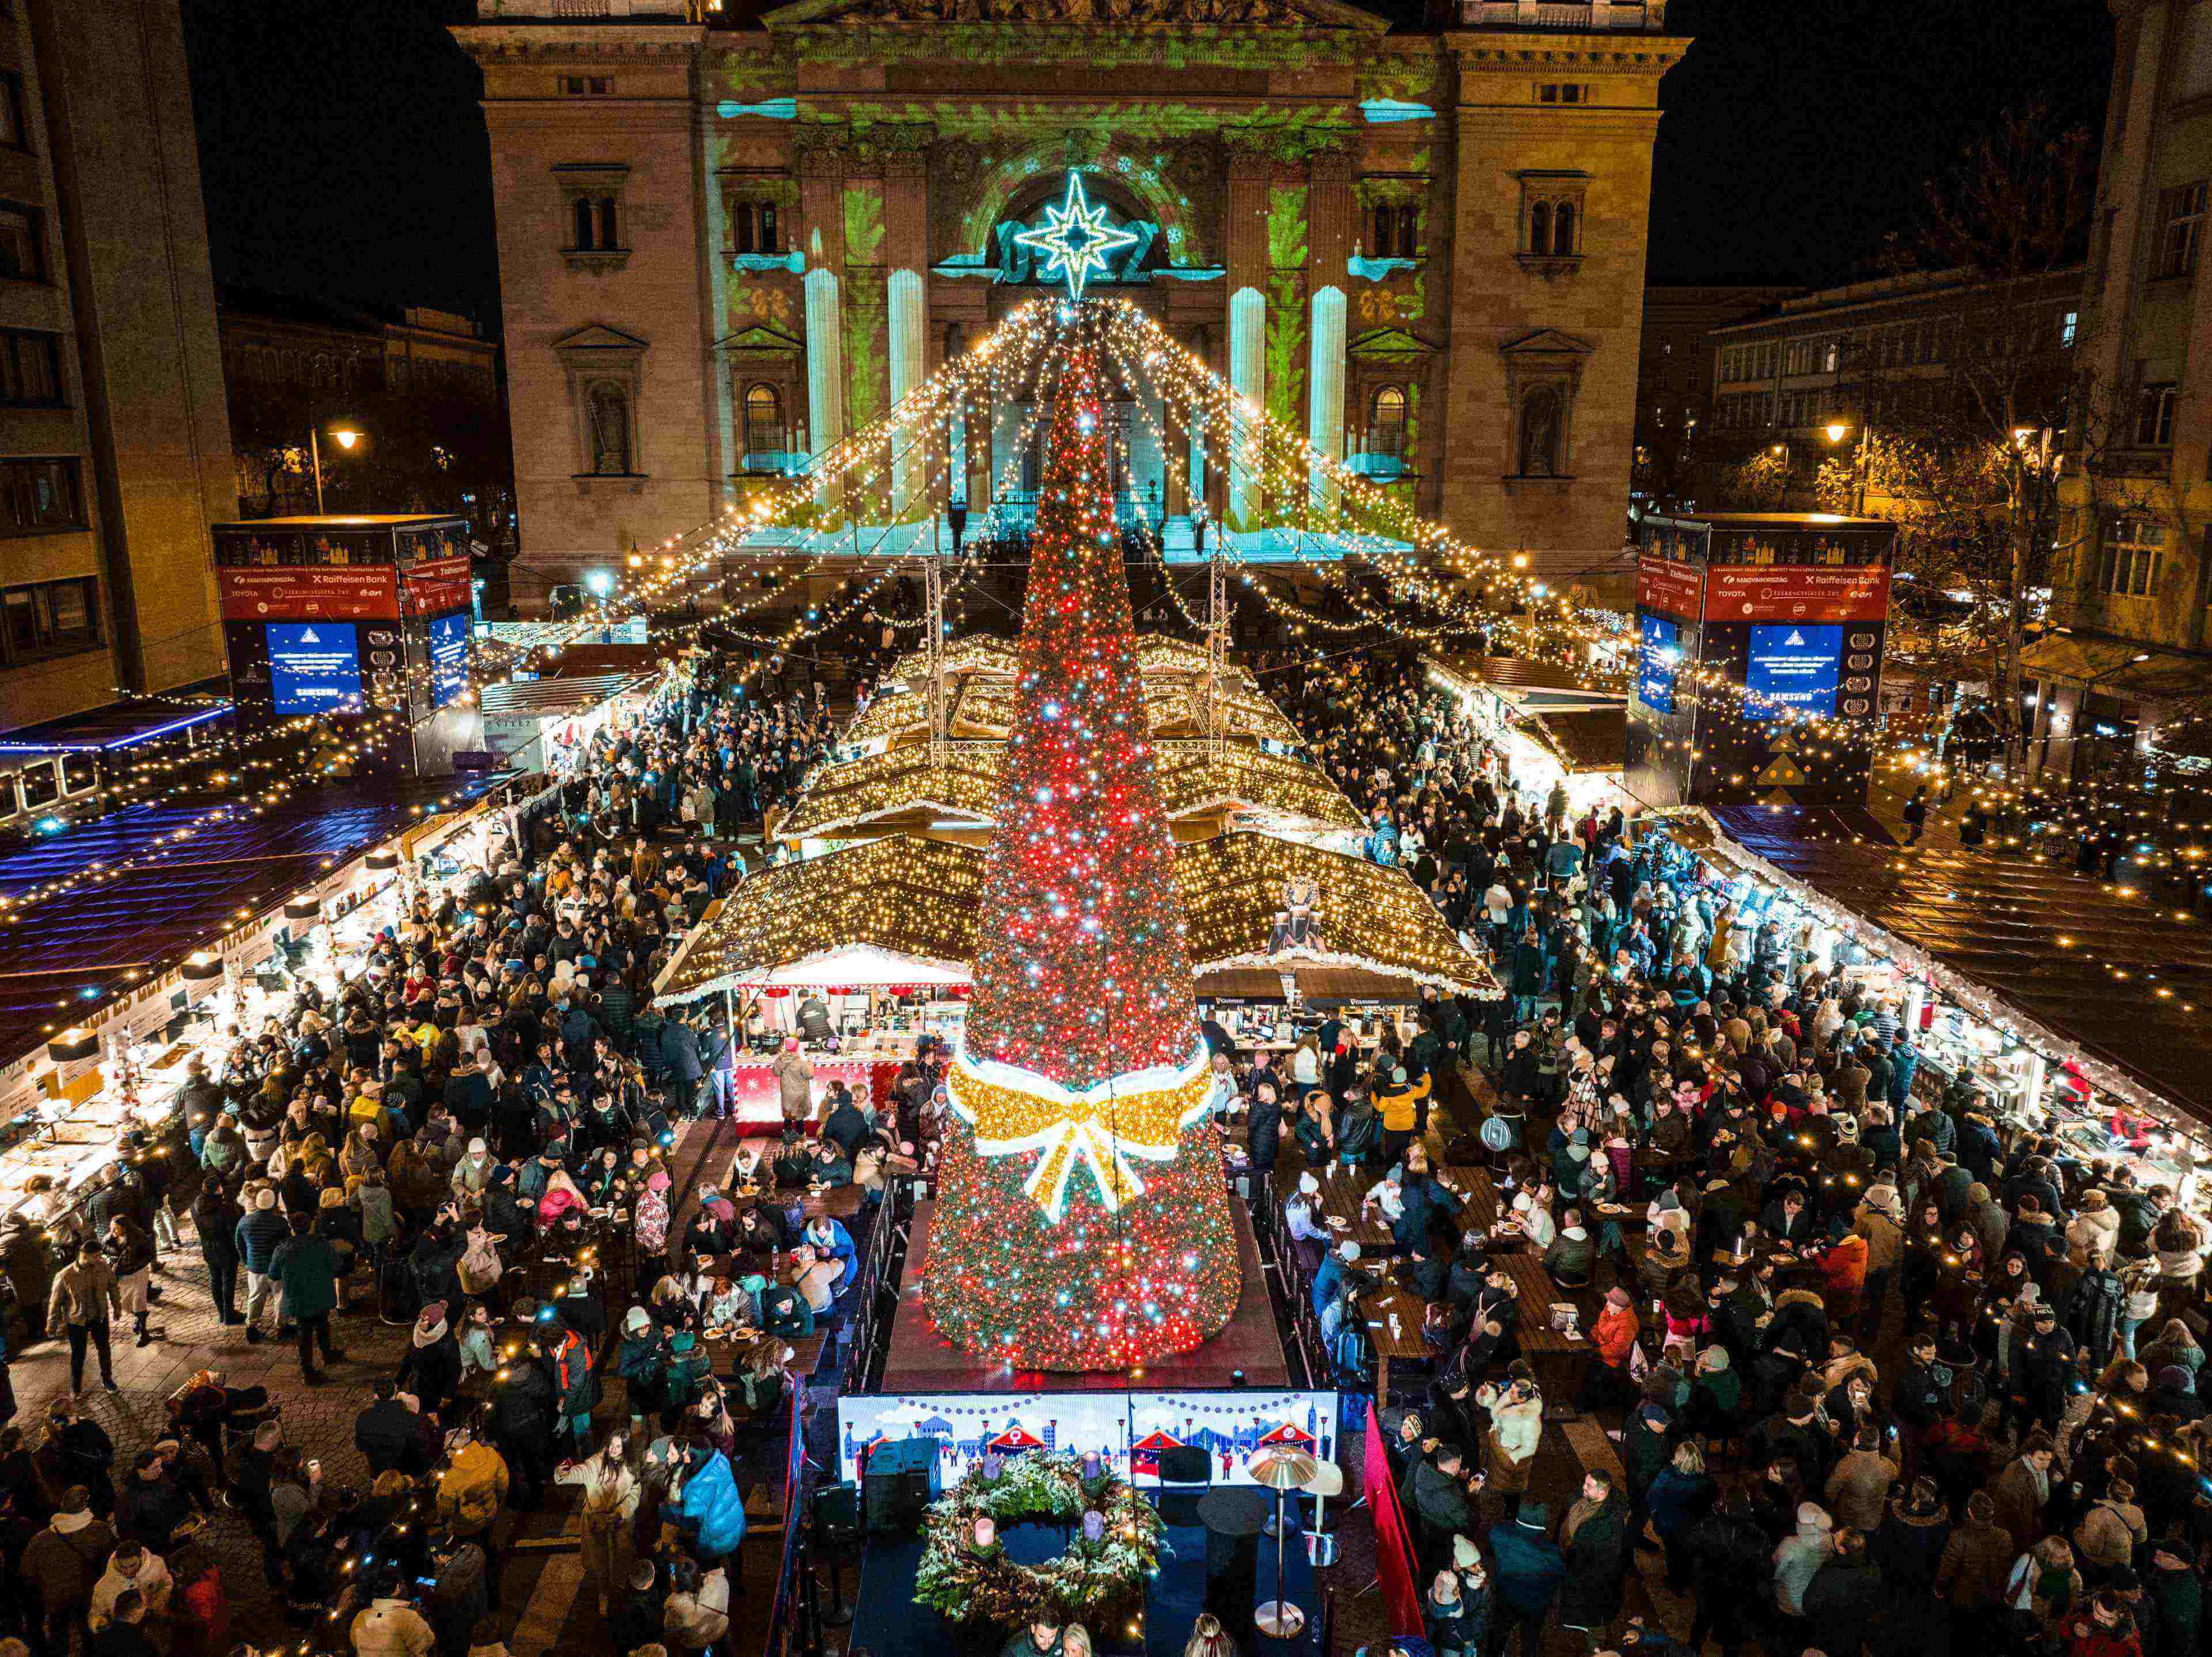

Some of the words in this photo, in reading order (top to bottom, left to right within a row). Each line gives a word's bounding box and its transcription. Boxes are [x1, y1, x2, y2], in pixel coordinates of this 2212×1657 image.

[323, 576, 365, 584] Raiffeisen
[1816, 576, 1857, 584] Raiffeisen
[1858, 576, 1880, 584] Bank
